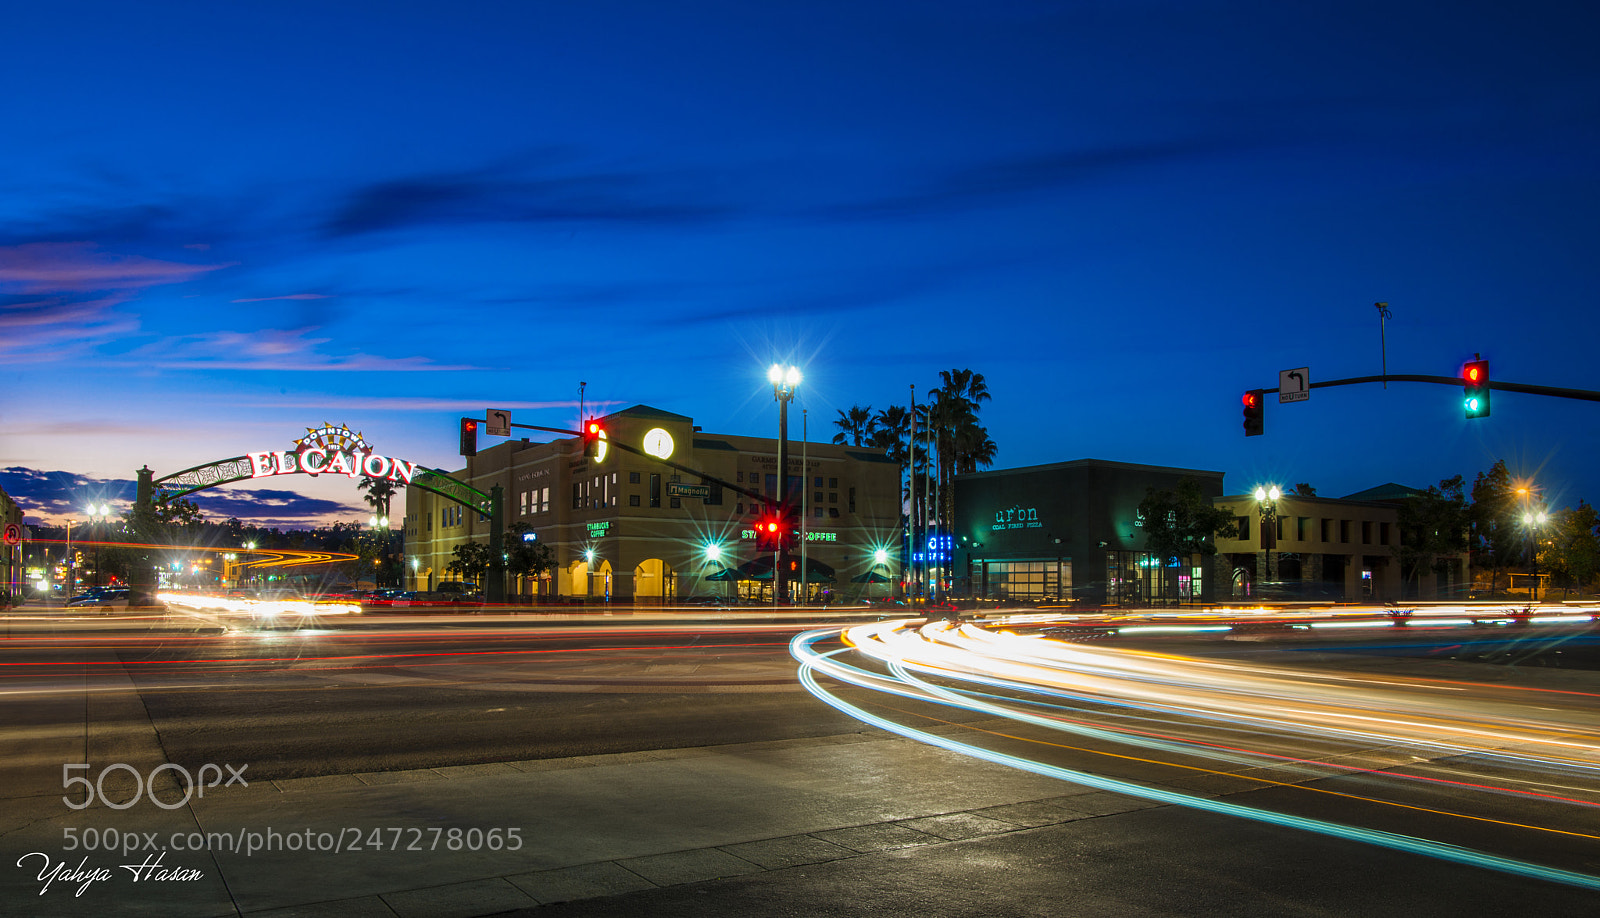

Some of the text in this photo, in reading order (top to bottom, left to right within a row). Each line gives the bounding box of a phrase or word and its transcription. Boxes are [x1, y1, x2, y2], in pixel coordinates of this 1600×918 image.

[303, 427, 366, 449] DOWNTOWN
[247, 447, 418, 484] EL CAJON
[678, 487, 709, 497] Magnolia
[586, 521, 610, 531] STARBUCKS
[590, 529, 606, 538] COFFEE
